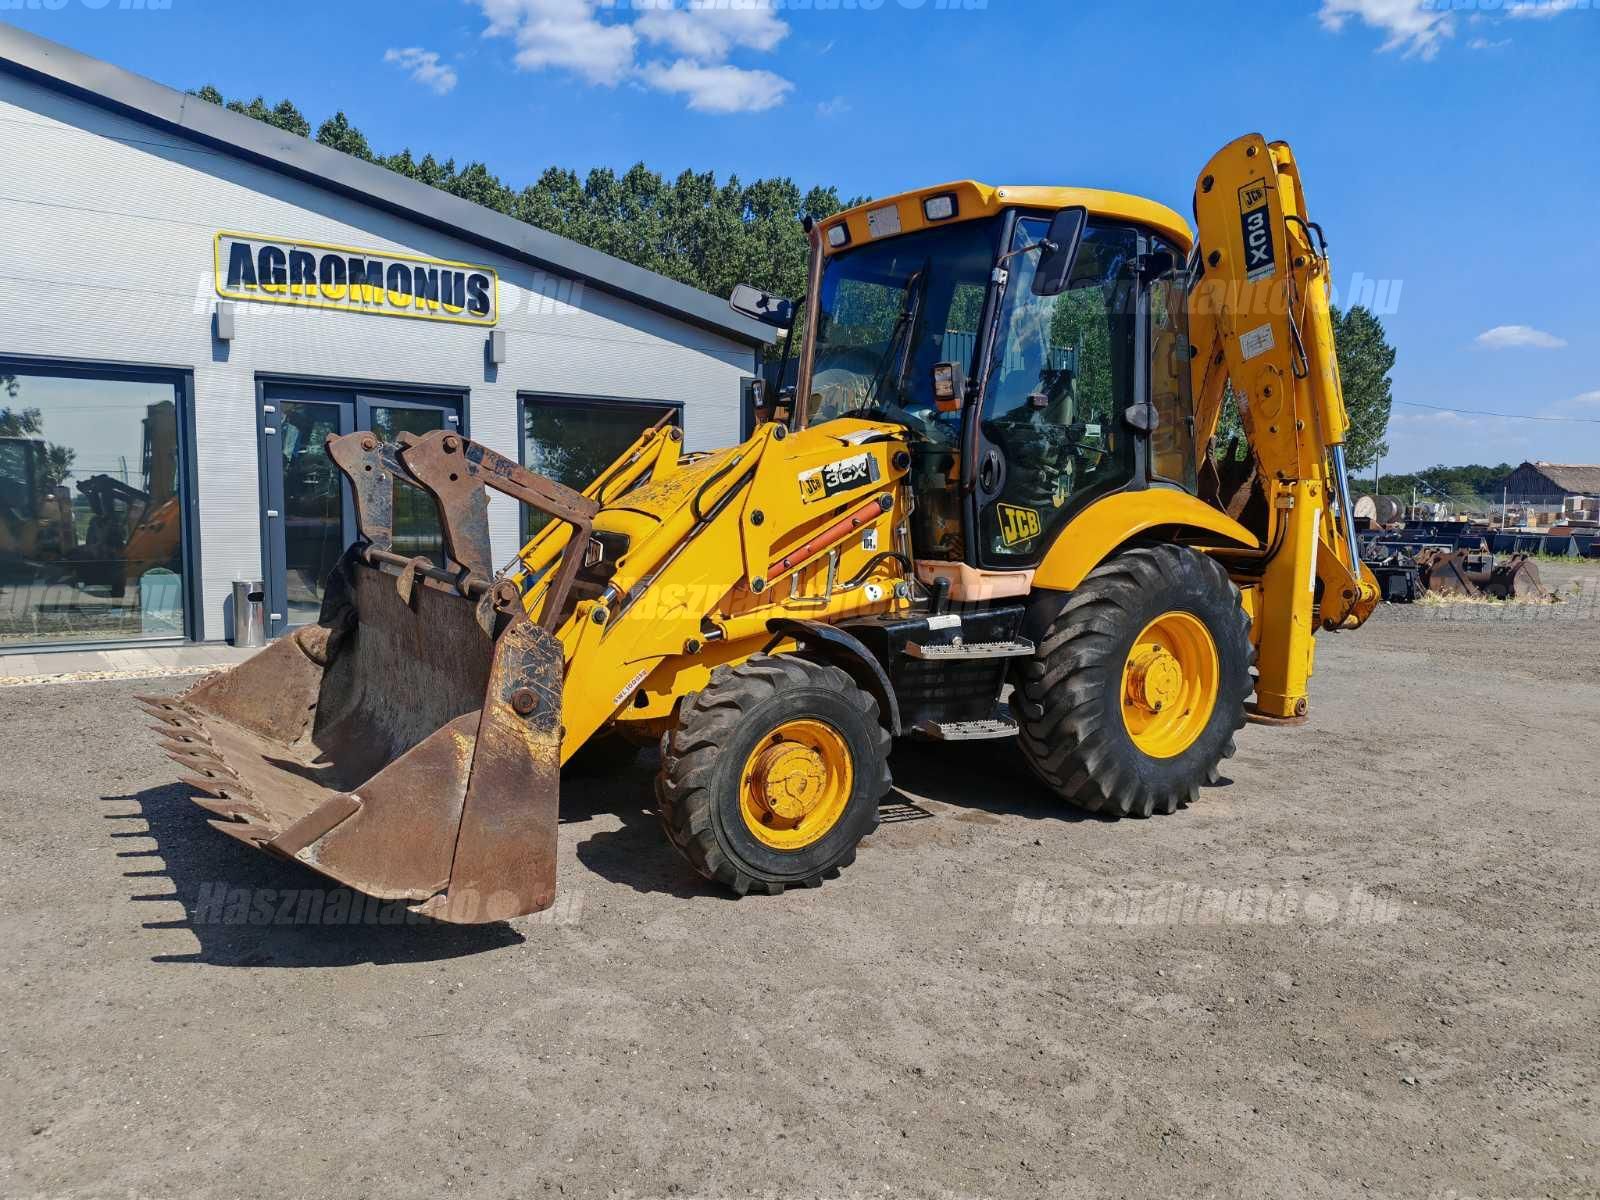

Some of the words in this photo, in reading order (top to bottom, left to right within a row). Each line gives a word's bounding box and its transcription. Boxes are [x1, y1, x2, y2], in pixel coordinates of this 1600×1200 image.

[1248, 212, 1269, 264] 3CX
[227, 242, 490, 317] AGROMONUS
[825, 461, 867, 488] 3CX
[1004, 507, 1039, 543] JCB
